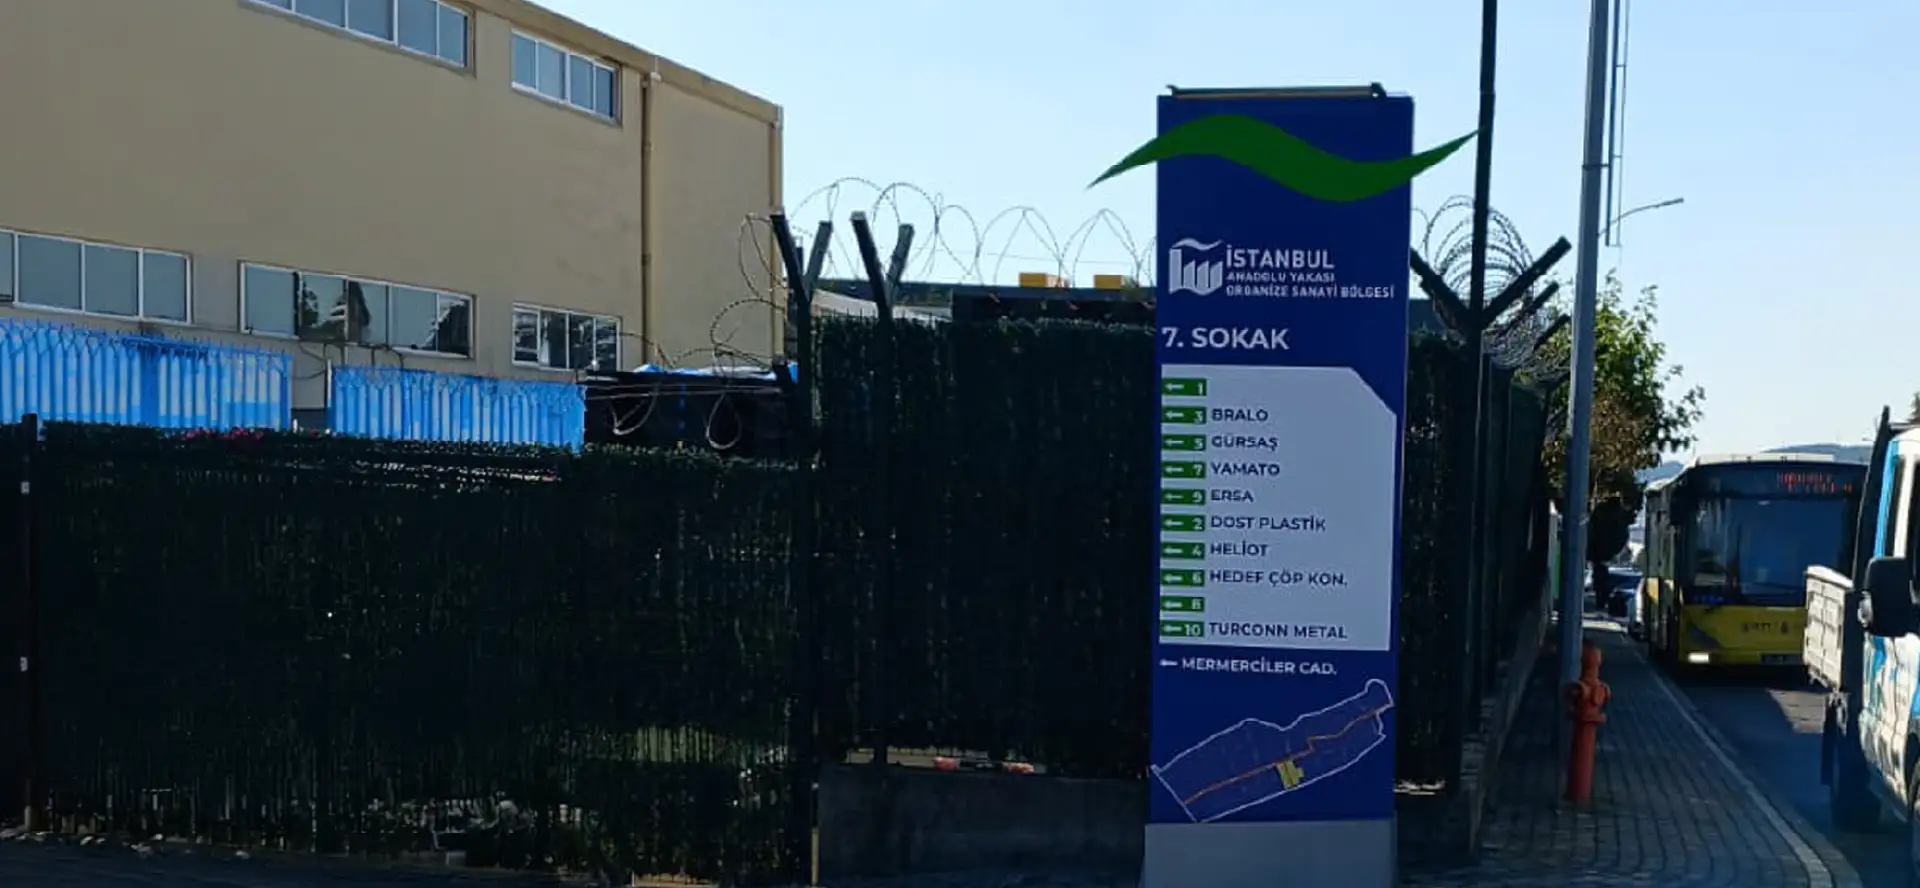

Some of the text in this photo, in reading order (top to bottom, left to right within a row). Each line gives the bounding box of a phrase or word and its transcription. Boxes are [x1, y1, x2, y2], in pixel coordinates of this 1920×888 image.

[1226, 244, 1335, 269] İSTANBUL
[1226, 272, 1335, 283] ANADOLU YAKASI
[1161, 327, 1290, 350] 7. SOKAK
[1211, 408, 1269, 422] BRALO
[1192, 462, 1281, 477] 7 YAMATO
[1210, 489, 1254, 502] ERSA
[1192, 515, 1326, 532] 2 DOST PLASTİK
[1210, 541, 1269, 556] HELİOT
[1209, 570, 1264, 584] HEDEF
[1268, 568, 1304, 587] ÇÖP
[1308, 573, 1348, 587] KON.
[1184, 621, 1348, 640] 10 TURCONN METAL
[1181, 655, 1338, 676] MERMERCİLER CAD.
